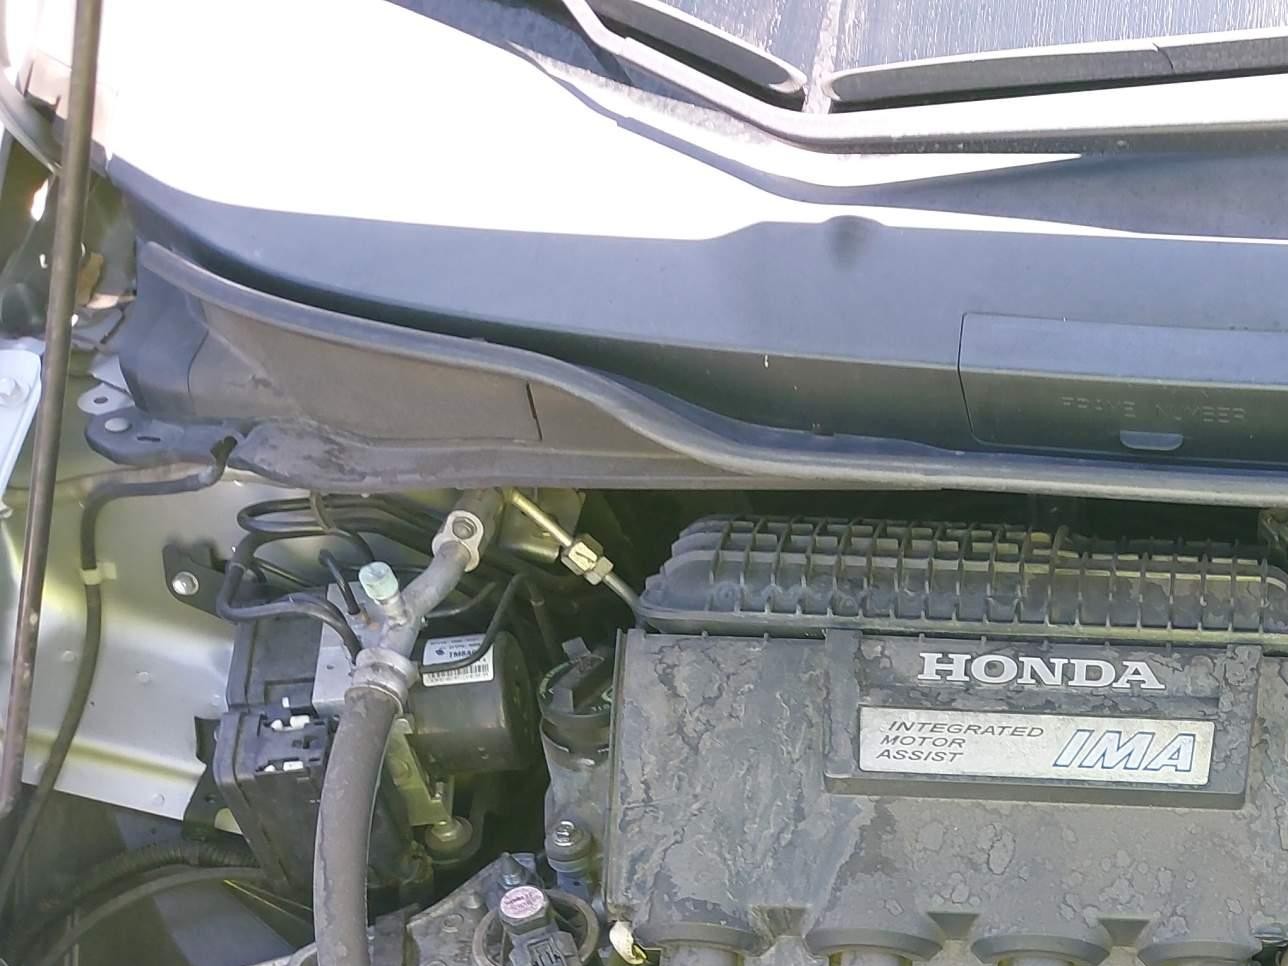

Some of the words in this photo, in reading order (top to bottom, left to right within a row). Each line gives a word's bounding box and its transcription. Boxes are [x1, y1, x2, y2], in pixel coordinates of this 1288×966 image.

[917, 652, 1167, 690] HONDA
[887, 720, 1045, 738] INTEGRATED
[879, 734, 967, 749] MOTOR
[1052, 728, 1197, 773] IMA
[875, 749, 964, 763] ASSIST
